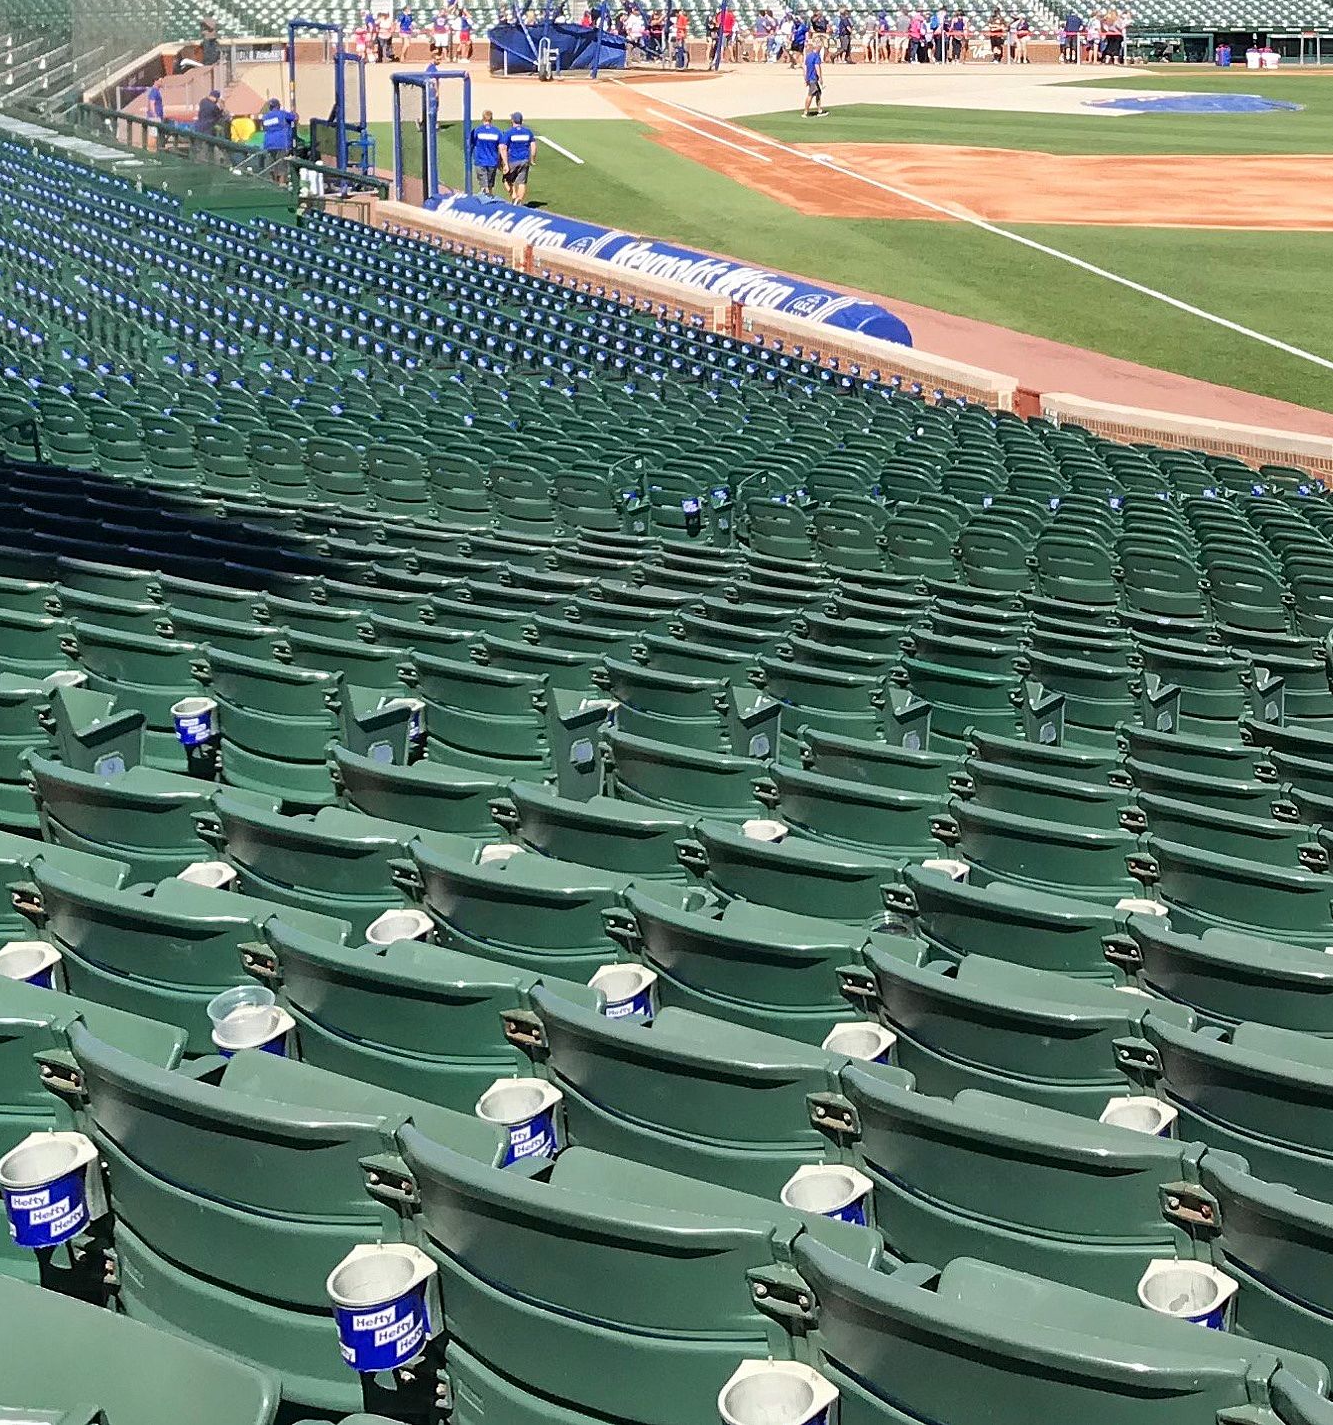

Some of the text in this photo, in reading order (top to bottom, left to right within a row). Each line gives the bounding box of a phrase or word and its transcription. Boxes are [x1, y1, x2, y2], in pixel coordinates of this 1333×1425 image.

[610, 240, 796, 311] Reynolds Wrap
[13, 1195, 46, 1207] Hefty
[33, 1203, 67, 1221] Hefty
[54, 1209, 82, 1232] Hefty
[356, 1312, 392, 1328] Hefty
[378, 1318, 412, 1342] Hefty
